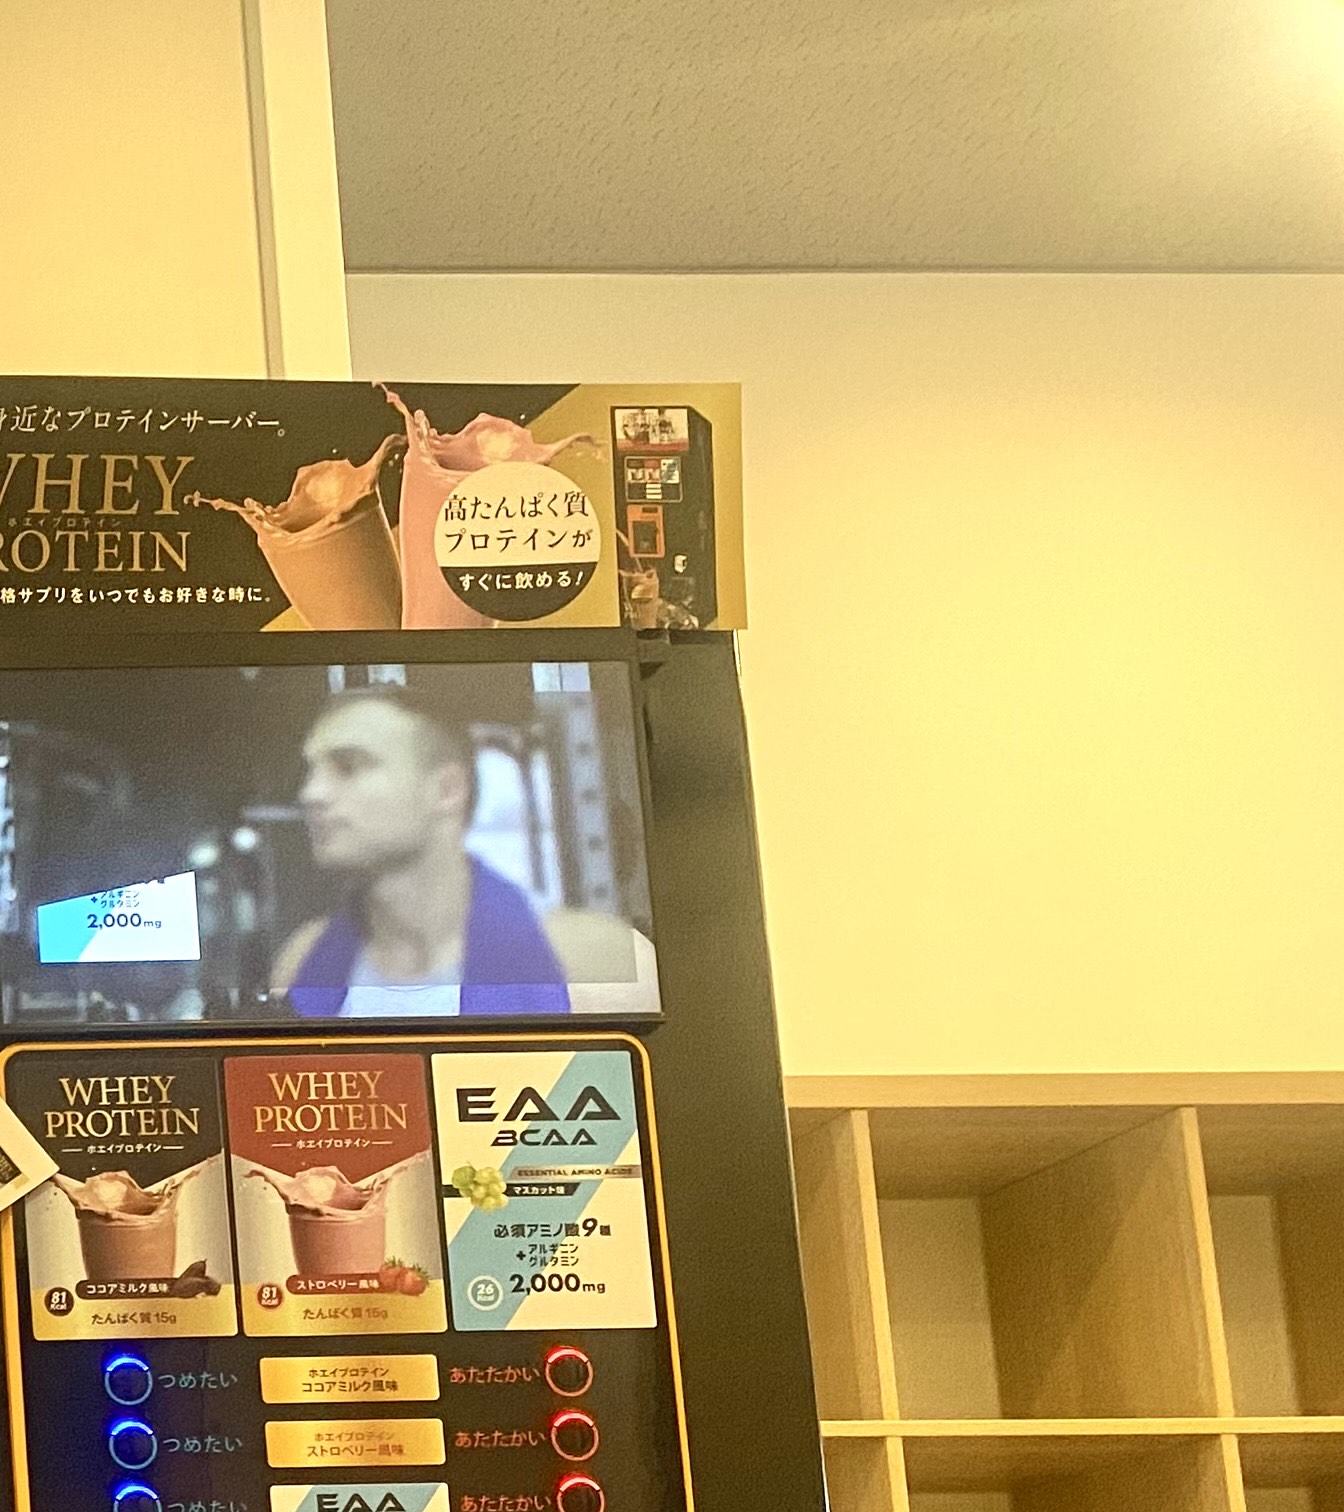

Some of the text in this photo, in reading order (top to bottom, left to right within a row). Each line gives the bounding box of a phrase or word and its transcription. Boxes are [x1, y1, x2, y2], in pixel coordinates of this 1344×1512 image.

[445, 491, 589, 521] 高たんぱく質
[445, 528, 593, 553] プロテインが
[60, 1076, 176, 1106] WHEY
[456, 1085, 621, 1122] EAA
[44, 1107, 200, 1139] PROTEIN
[87, 1142, 161, 1154] ホエイプロテイン
[518, 1168, 567, 1176] ESSENTIAL
[571, 1168, 601, 1176] AMINO
[52, 1290, 67, 1304] 81
[478, 1284, 495, 1294] 26
[158, 1371, 237, 1389] つめたい
[450, 1366, 540, 1384] あたたかい
[301, 1379, 399, 1393] ココアミルク風味
[164, 1436, 242, 1453] つめたい
[455, 1430, 546, 1448] あたたかい
[307, 1443, 405, 1457] ストロベリー風味
[316, 1492, 406, 1512] EAA
